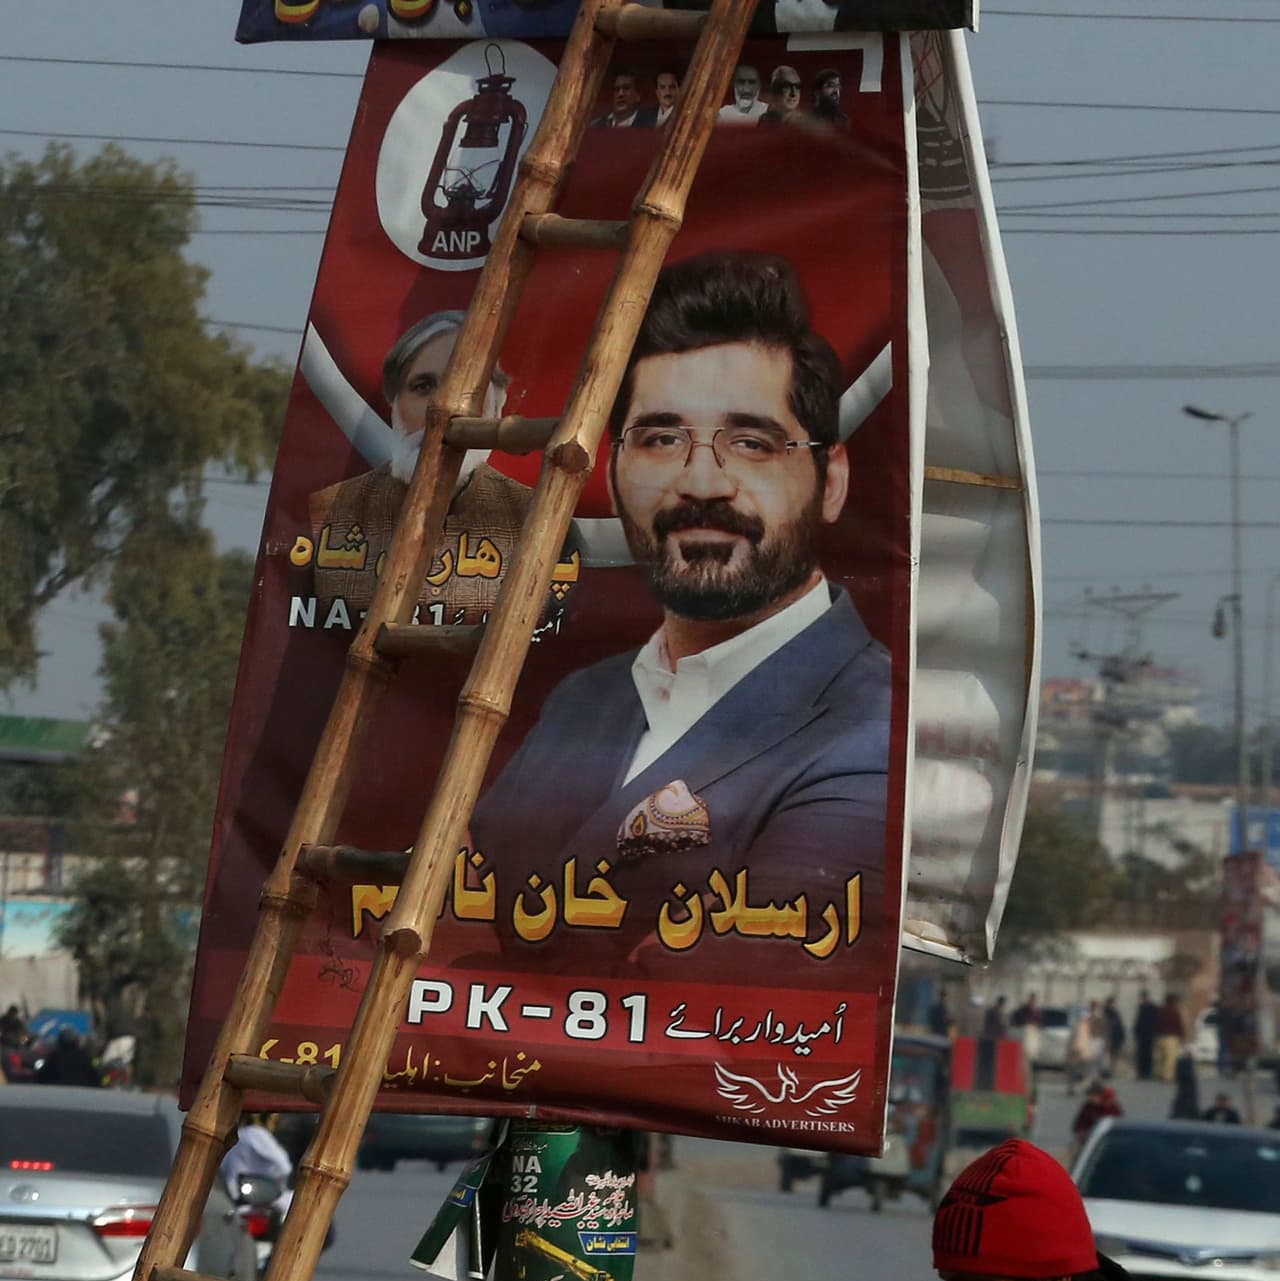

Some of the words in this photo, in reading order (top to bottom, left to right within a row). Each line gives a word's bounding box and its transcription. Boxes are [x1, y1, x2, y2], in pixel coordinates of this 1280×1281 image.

[431, 231, 482, 256] ANP
[289, 524, 369, 570] شاہ
[351, 848, 497, 940] نام
[512, 857, 629, 942] خان
[658, 867, 863, 958] ارسلان
[407, 978, 648, 1045] PK-81
[664, 1002, 743, 1045] برائے
[764, 1119, 856, 1133] ADVERTISERS
[510, 1175, 538, 1193] 32
[512, 1155, 542, 1173] NA
[586, 1236, 607, 1251] نشان
